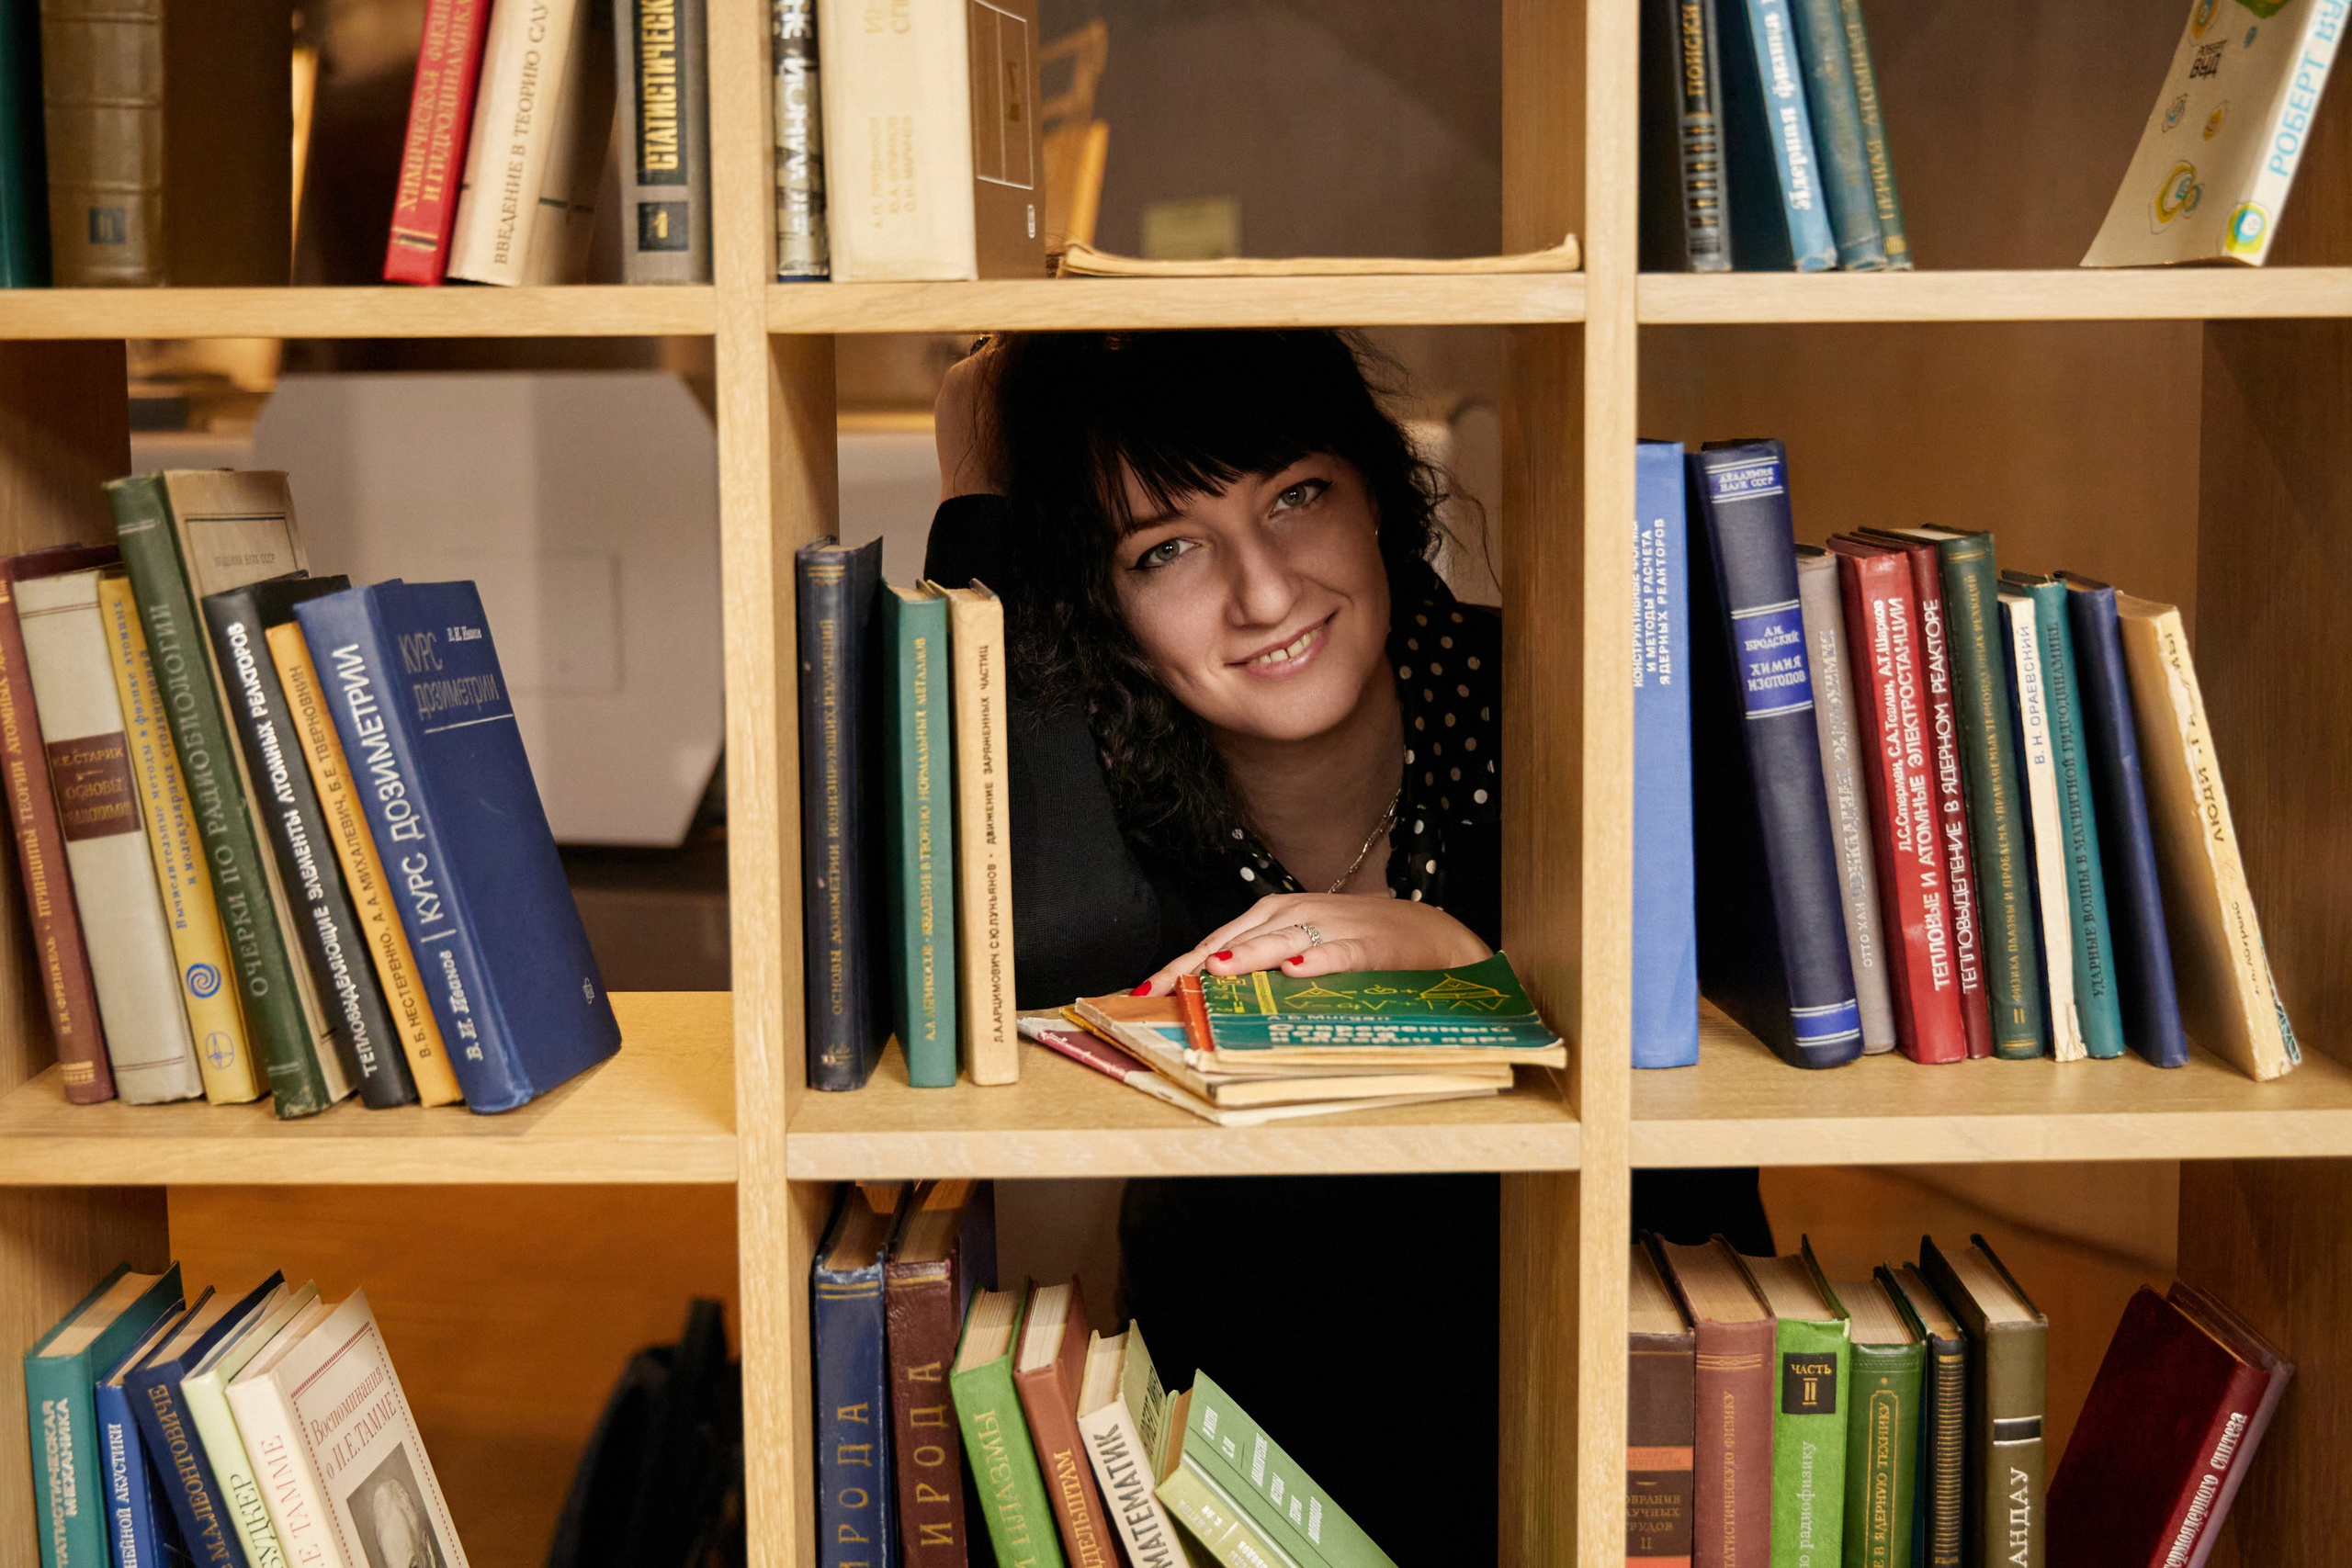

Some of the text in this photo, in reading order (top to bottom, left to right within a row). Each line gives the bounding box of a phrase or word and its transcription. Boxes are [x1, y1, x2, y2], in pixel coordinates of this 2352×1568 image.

[1681, 4, 1704, 95] ПОИСКИ
[2189, 53, 2222, 80] ВУД
[513, 49, 540, 139] ТЕОРИЮ
[1758, 9, 1815, 211] Ядерная физика
[2267, 50, 2326, 177] РОБЕРТ
[399, 69, 439, 211] ХИМИЧЕСКАЯ
[512, 142, 525, 155] В
[494, 161, 524, 265] ВВЕДЕНИЕ
[654, 210, 668, 238] 1
[1750, 476, 1775, 488] СССР
[110, 600, 134, 666] атомных
[1632, 573, 1644, 687] КОНСТРУКТИВНЫЕ
[1641, 530, 1657, 671] И МЕТОДЫ РАСЧЕТА
[1654, 518, 1671, 684] ЯДЕРНЫХ РЕАКТОРОВ
[1966, 573, 1984, 632] РЕАКЦИЙ
[398, 632, 443, 674] КУРС
[978, 645, 990, 689] ЧАСТИЦ
[1745, 629, 1800, 651] БРОДСКИЙ
[1749, 655, 1802, 676] ХИМИЯ
[124, 671, 150, 727] физике
[1747, 670, 1806, 692] ИЗОТОПОВ
[2016, 626, 2045, 765] В. Н. ОРАЕВСКИЙ
[915, 709, 930, 799] НОРМАЛЬНЫХ
[980, 695, 994, 774] ЗАРЯЖЕННЫХ
[9, 759, 35, 824] ТЕОРИИ
[64, 777, 123, 798] ОСНОВЫ
[141, 744, 160, 799] методы
[146, 601, 272, 998] ОЧЕРКИ ПО РАДИОБИОЛОГИИ
[1888, 596, 1951, 991] ТЕПЛОВЫЕ И АТОМНЫЕ ЭЛЕКТРОСТАНЦИИ
[1922, 598, 1978, 994] ТЕПЛОВЫДЕЛЕНИЕ В ЯДЕРНОМ РЕАКТОРЕ
[1984, 732, 2007, 821] УПРАВЛЯЕМЫХ
[163, 762, 198, 871] молекулярных
[334, 793, 376, 891] МИХАЛЕВИЧ,
[919, 805, 932, 859] ТЕОРИЮ
[984, 782, 997, 844] ДВИЖЕНИЕ
[2045, 622, 2106, 997] УДАРНЫЕ ВОЛНЫ В МАГНИТНОЙ ГИДРОДИНАМИКЕ
[22, 828, 53, 918] ПРИНЦИПЫ
[150, 805, 188, 930] Вычислительные
[225, 621, 382, 1078] ТЕПЛОВЫДЕЛЯЮЩИЕ ЭЛЕМЕНТЫ АТОМНЫХ РЕАКТОРОВ
[331, 641, 483, 1064] В. И. Иванов КУРС ДОЗИМЕТРИИ
[920, 861, 931, 870] В
[1997, 822, 2013, 887] ПРОБЛЕМА
[828, 843, 842, 943] ДОЗИМЕТРИИ
[919, 873, 933, 935] ВВЕДЕНИЕ
[2004, 890, 2014, 900] И
[1853, 900, 1874, 968] ОТТО ХАН
[2006, 903, 2018, 952] ПЛАЗМЫ
[830, 950, 843, 1015] ОСНОВЫ
[2009, 954, 2022, 1002] ФИЗИКА
[1791, 1363, 1833, 1375] ЧАСТЬ
[1803, 1378, 1818, 1405] II
[311, 1366, 384, 1446] Воспоминания
[1723, 1391, 1735, 1448] ФИЗИКУ
[1876, 1402, 1890, 1466] ТЕХНИКУ
[2208, 1408, 2249, 1472] синтеза
[56, 1397, 77, 1517] МЕХАНИКА
[106, 1422, 130, 1505] АКУСТИКИ
[259, 1432, 312, 1539] ТАММЕ
[326, 1461, 335, 1479] о
[906, 1360, 956, 1546] ИРОДА
[972, 1408, 1031, 1547] ПЛАЗМЫ
[1798, 1440, 1815, 1549] радиофизику
[1875, 1472, 1888, 1540] ЯДЕРНУЮ
[2008, 1466, 2030, 1568] АНДАУ
[1873, 1546, 1884, 1554] В
